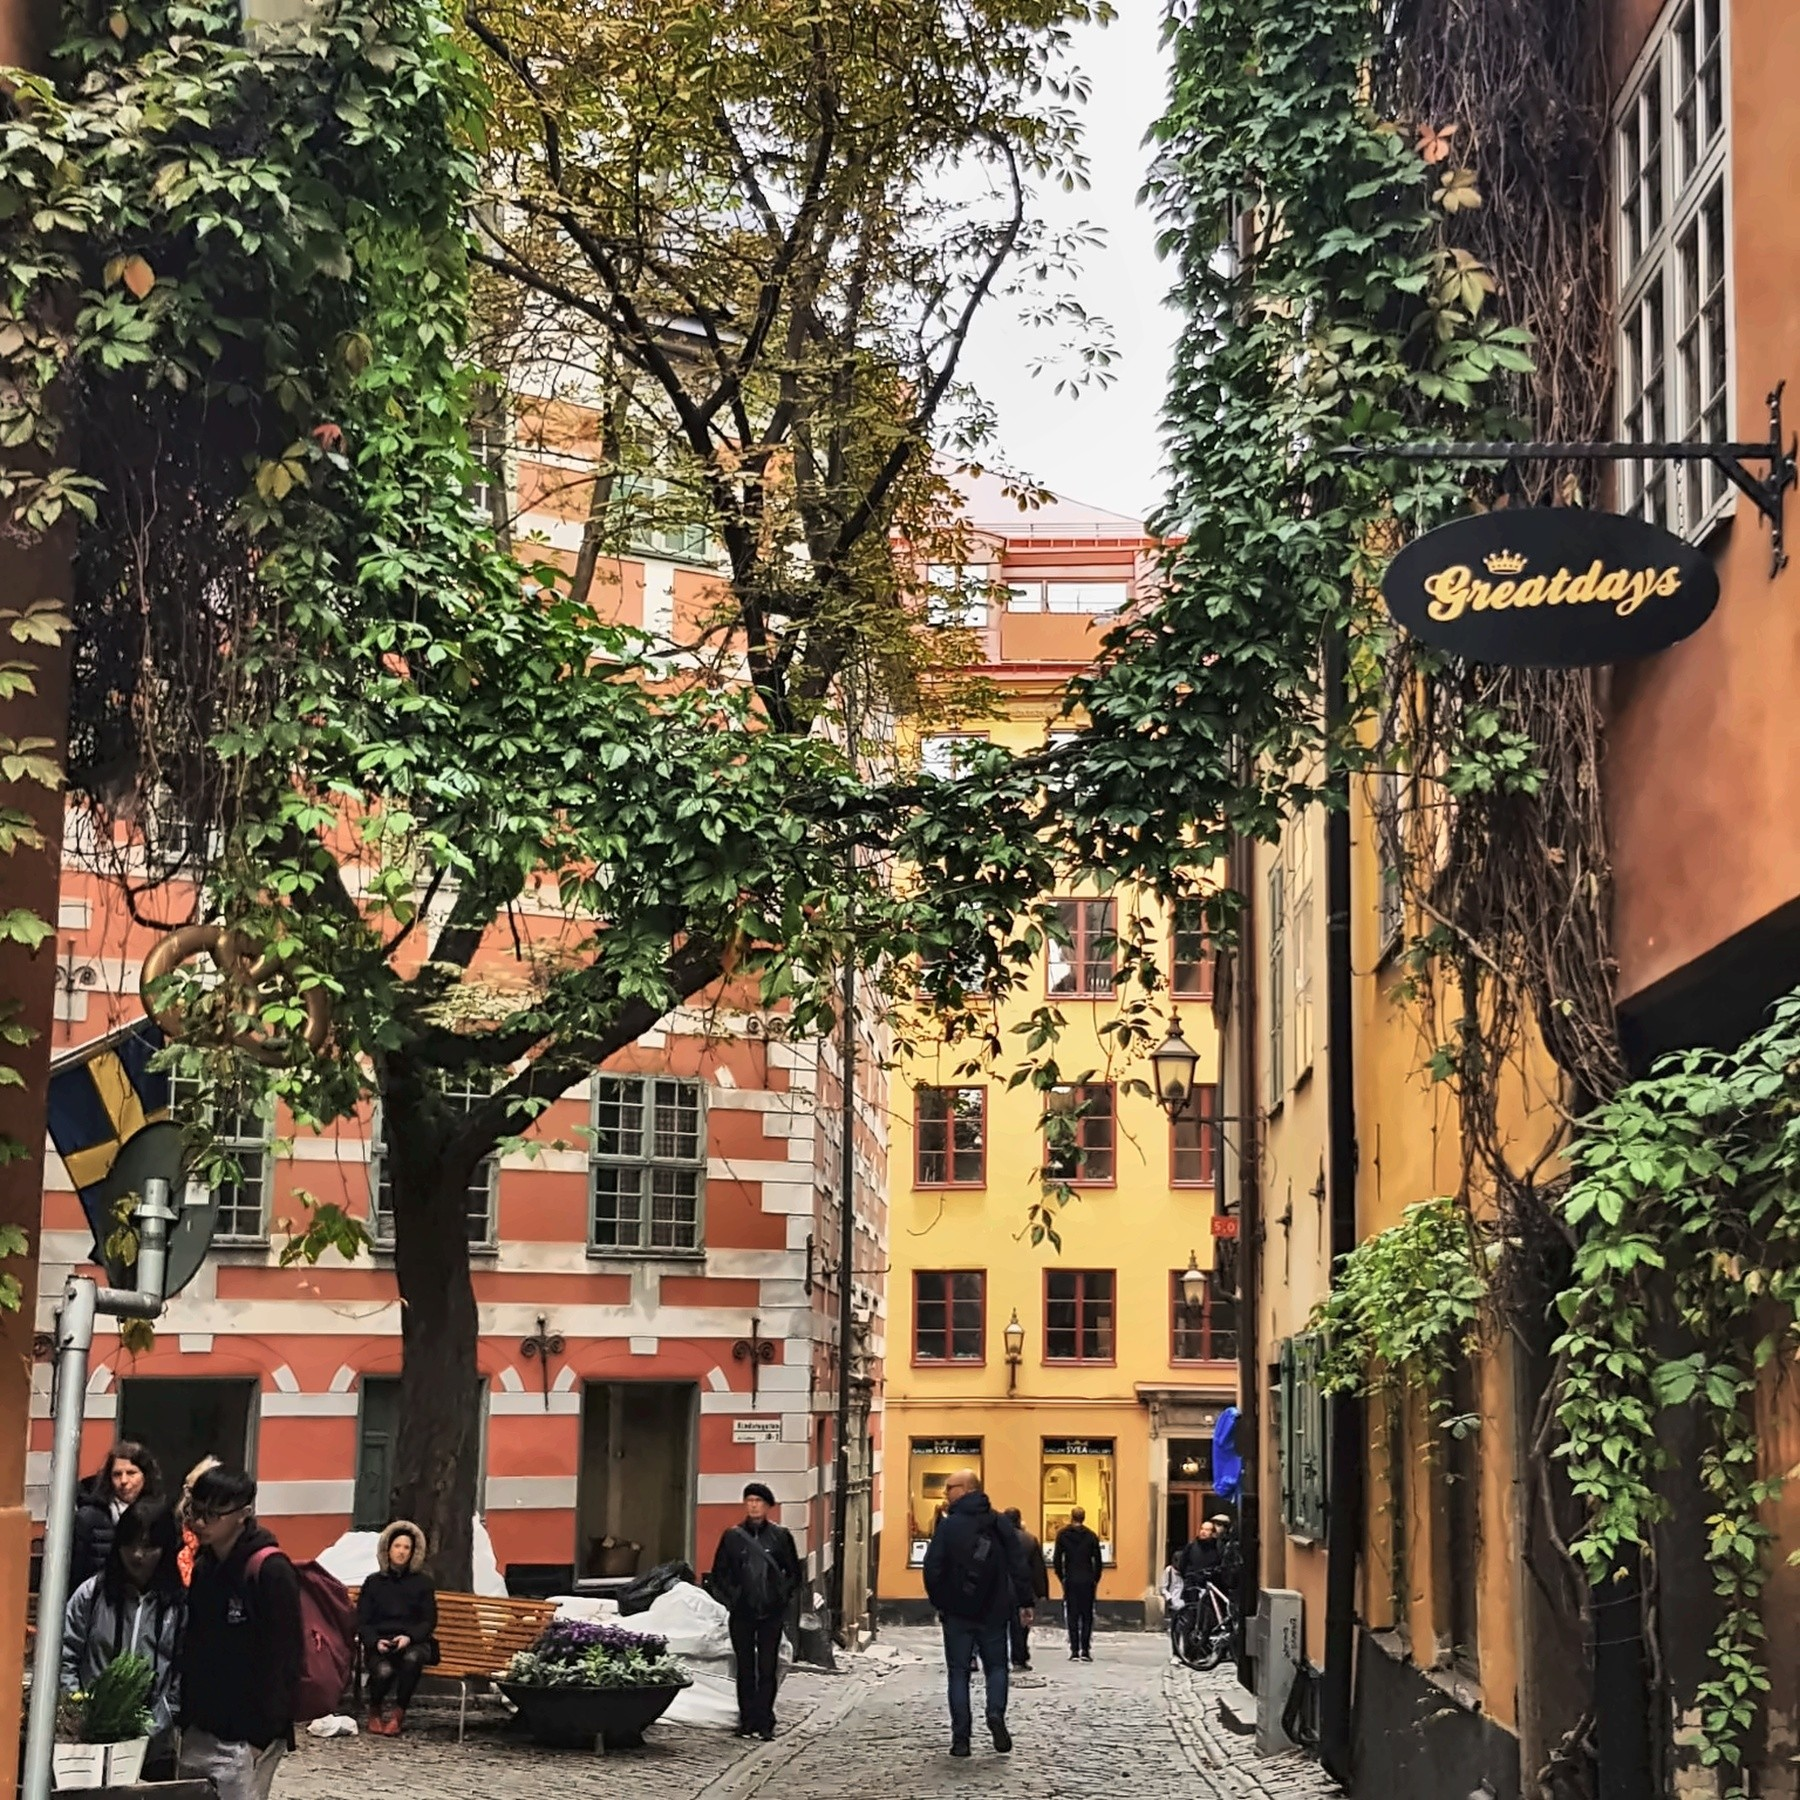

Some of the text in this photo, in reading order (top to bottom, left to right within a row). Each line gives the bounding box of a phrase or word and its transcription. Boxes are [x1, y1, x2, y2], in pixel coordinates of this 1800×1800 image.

[1424, 559, 1682, 622] Greatdays
[934, 1446, 956, 1454] SVEA
[1066, 1446, 1088, 1454] SVEA
